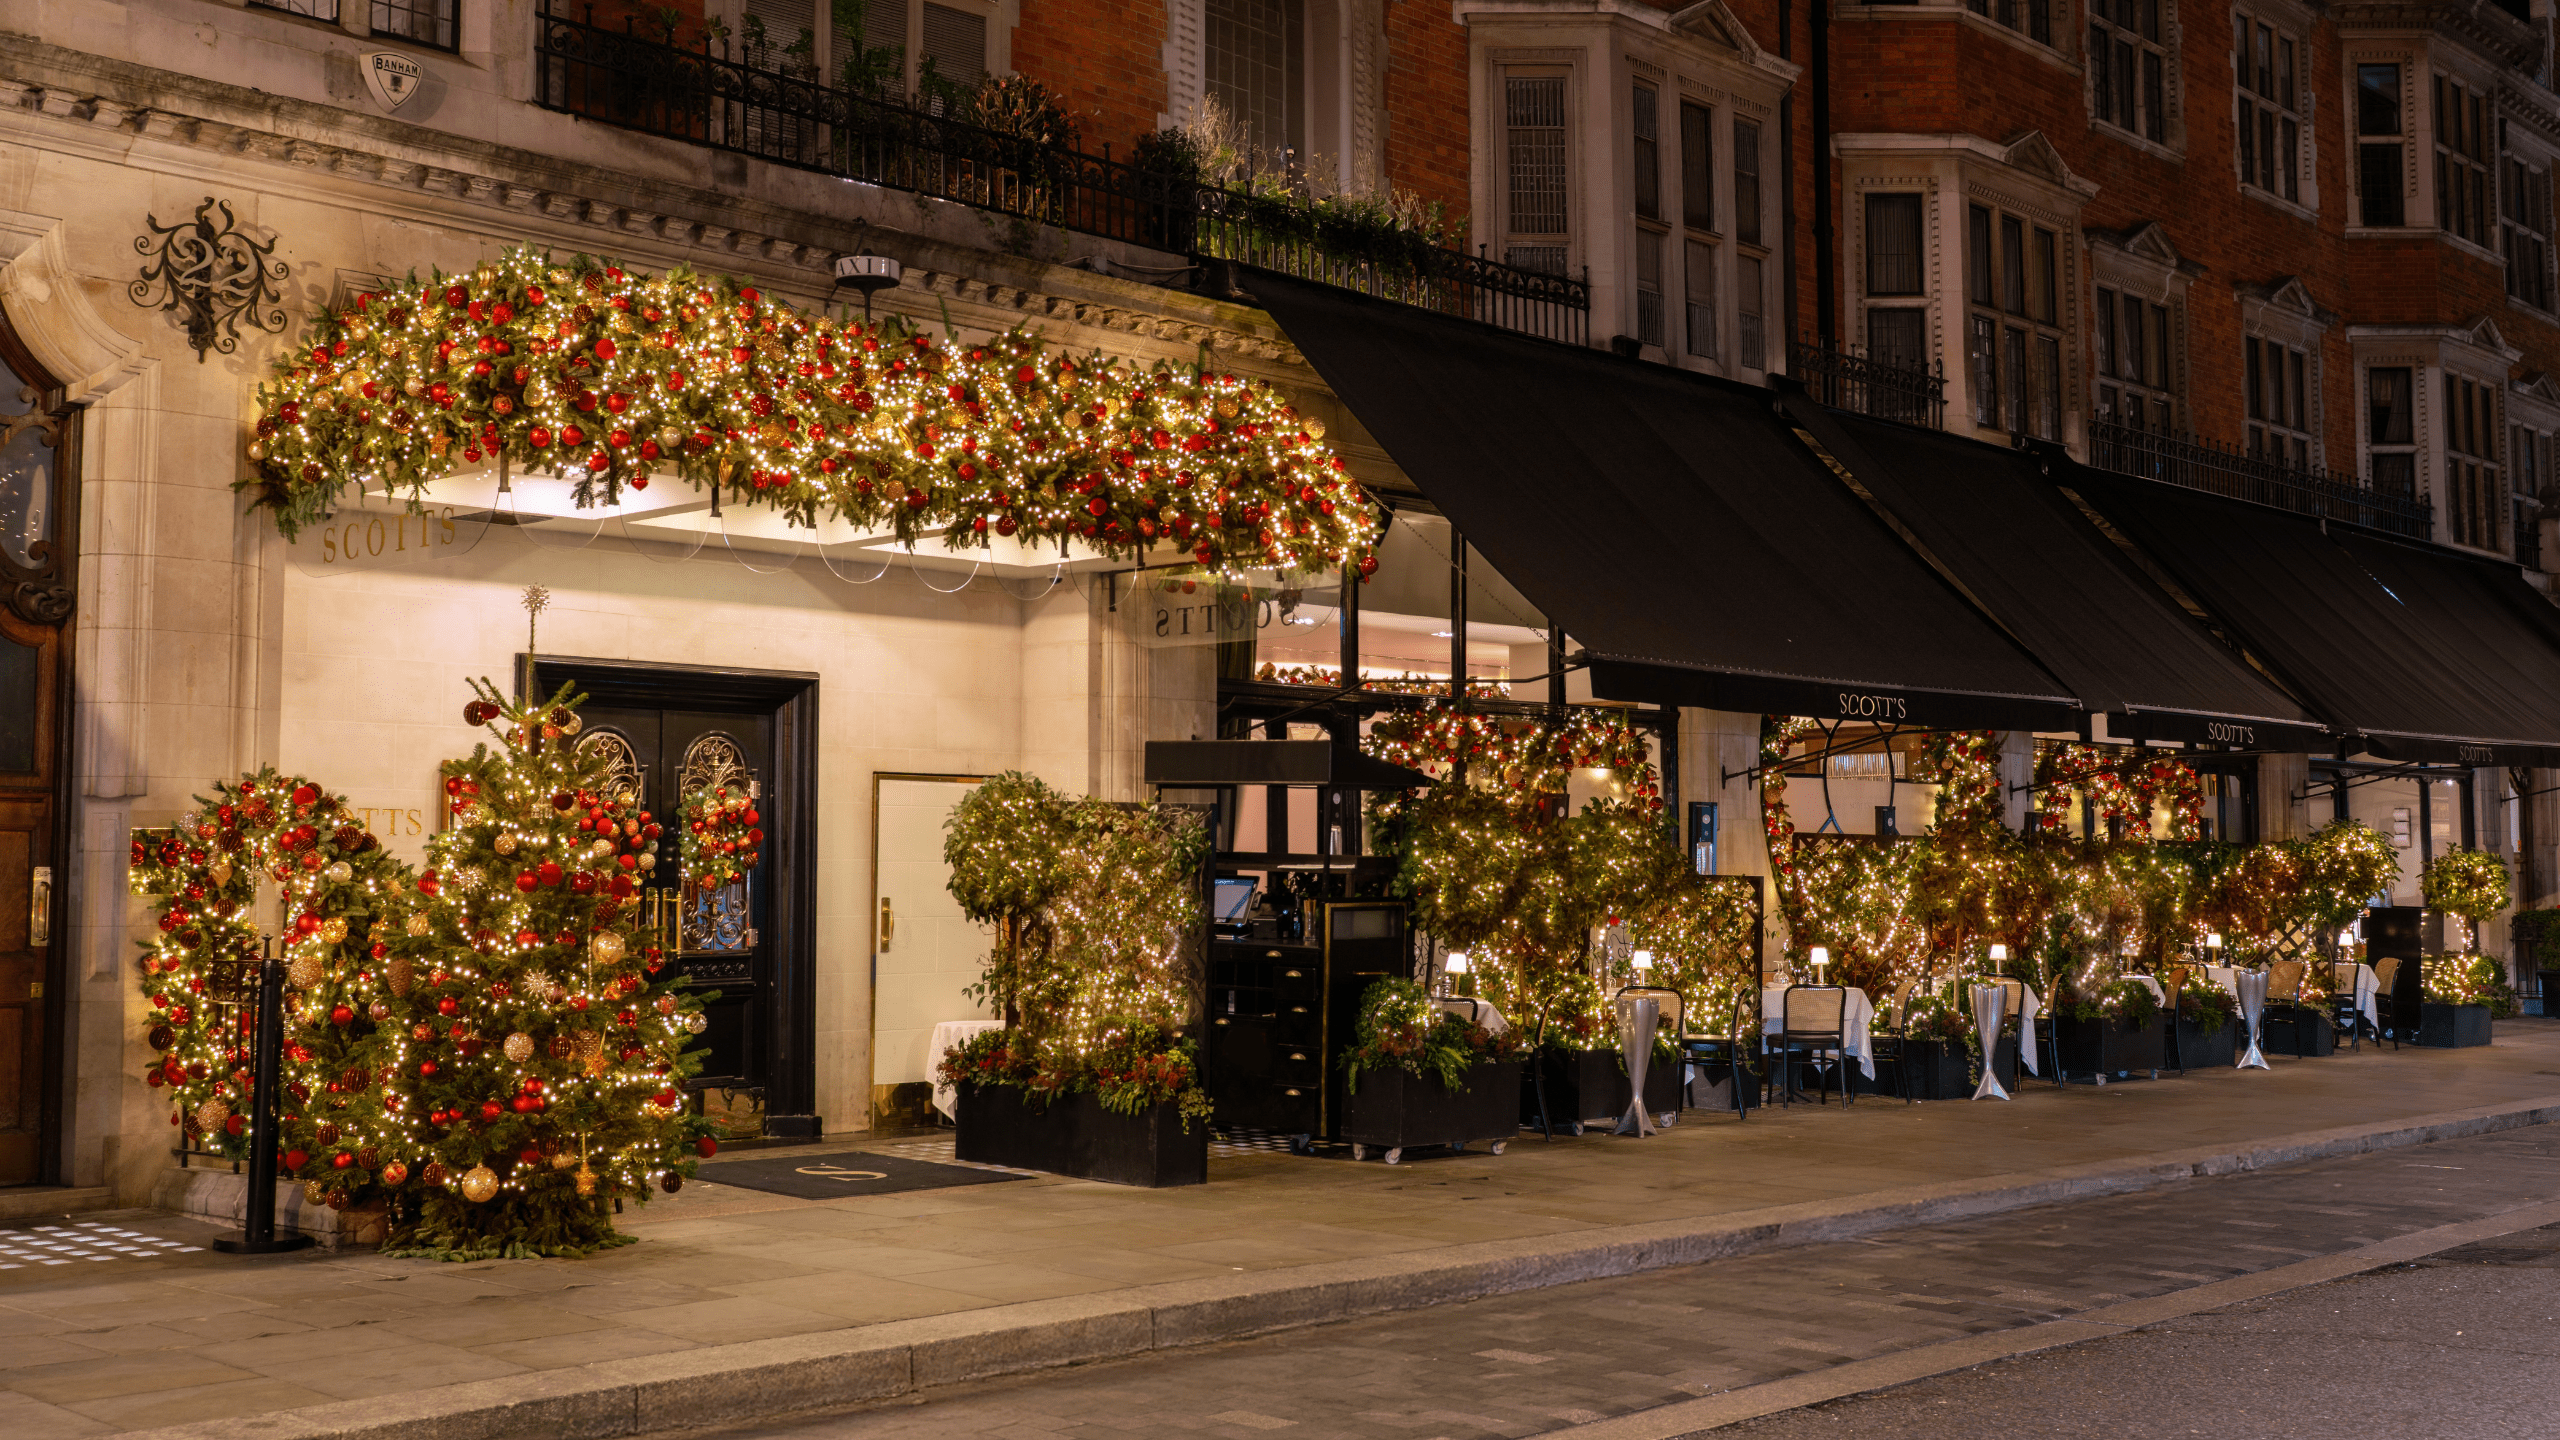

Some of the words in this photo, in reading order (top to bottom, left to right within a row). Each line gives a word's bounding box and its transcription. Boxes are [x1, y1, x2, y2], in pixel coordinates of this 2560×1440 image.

[375, 57, 418, 76] BANHAM
[179, 236, 258, 298] 22
[323, 506, 455, 564] SCOTTS
[1839, 693, 1907, 719] SCOTT'S
[2208, 722, 2254, 744] SCOTT'S
